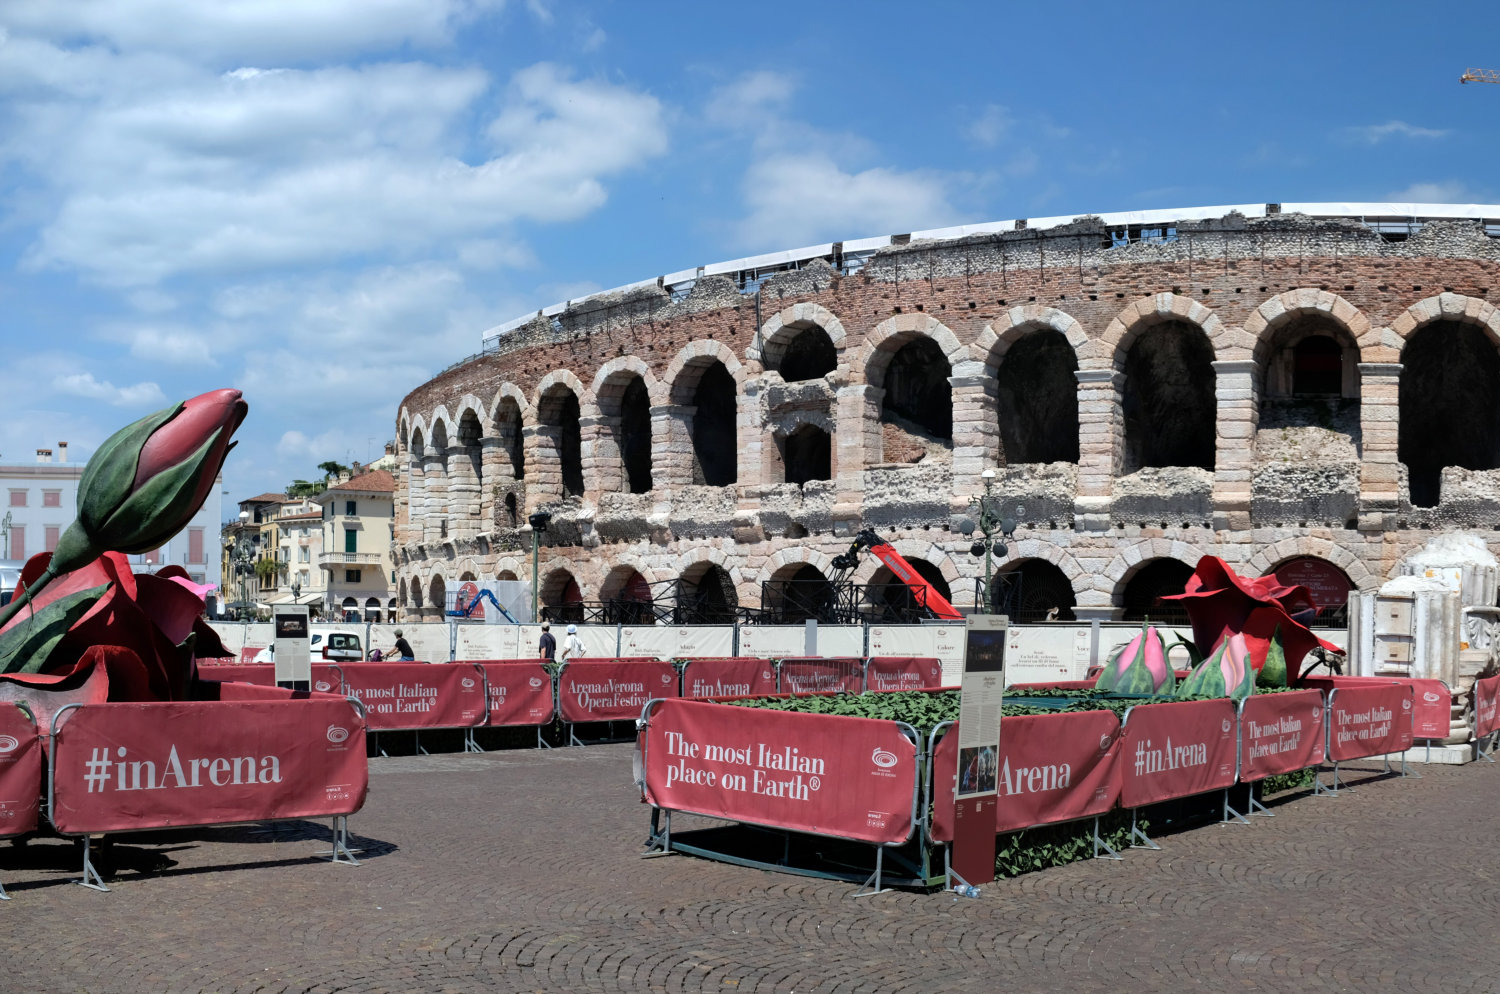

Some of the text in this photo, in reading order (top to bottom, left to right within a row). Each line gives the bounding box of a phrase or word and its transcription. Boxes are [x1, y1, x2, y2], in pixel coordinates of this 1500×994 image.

[785, 671, 809, 683] Arena
[872, 669, 893, 681] Arena
[897, 669, 920, 680] Verona
[365, 685, 395, 699] most
[399, 683, 438, 698] Italian
[568, 679, 601, 694] Arena
[608, 678, 644, 692] Verona
[692, 678, 750, 697] #inArena
[377, 703, 392, 713] on
[577, 691, 652, 712] Opera Festival
[1337, 706, 1392, 725] The most Italian
[1248, 715, 1302, 739] The most Italian
[1337, 726, 1358, 748] place
[1359, 730, 1368, 740] on
[665, 731, 826, 776] The most Italian
[1135, 735, 1207, 777] #inArena
[1249, 740, 1269, 765] place
[1269, 742, 1278, 755] on
[84, 743, 283, 793] #inArena
[665, 759, 716, 788] place
[721, 772, 747, 792] on
